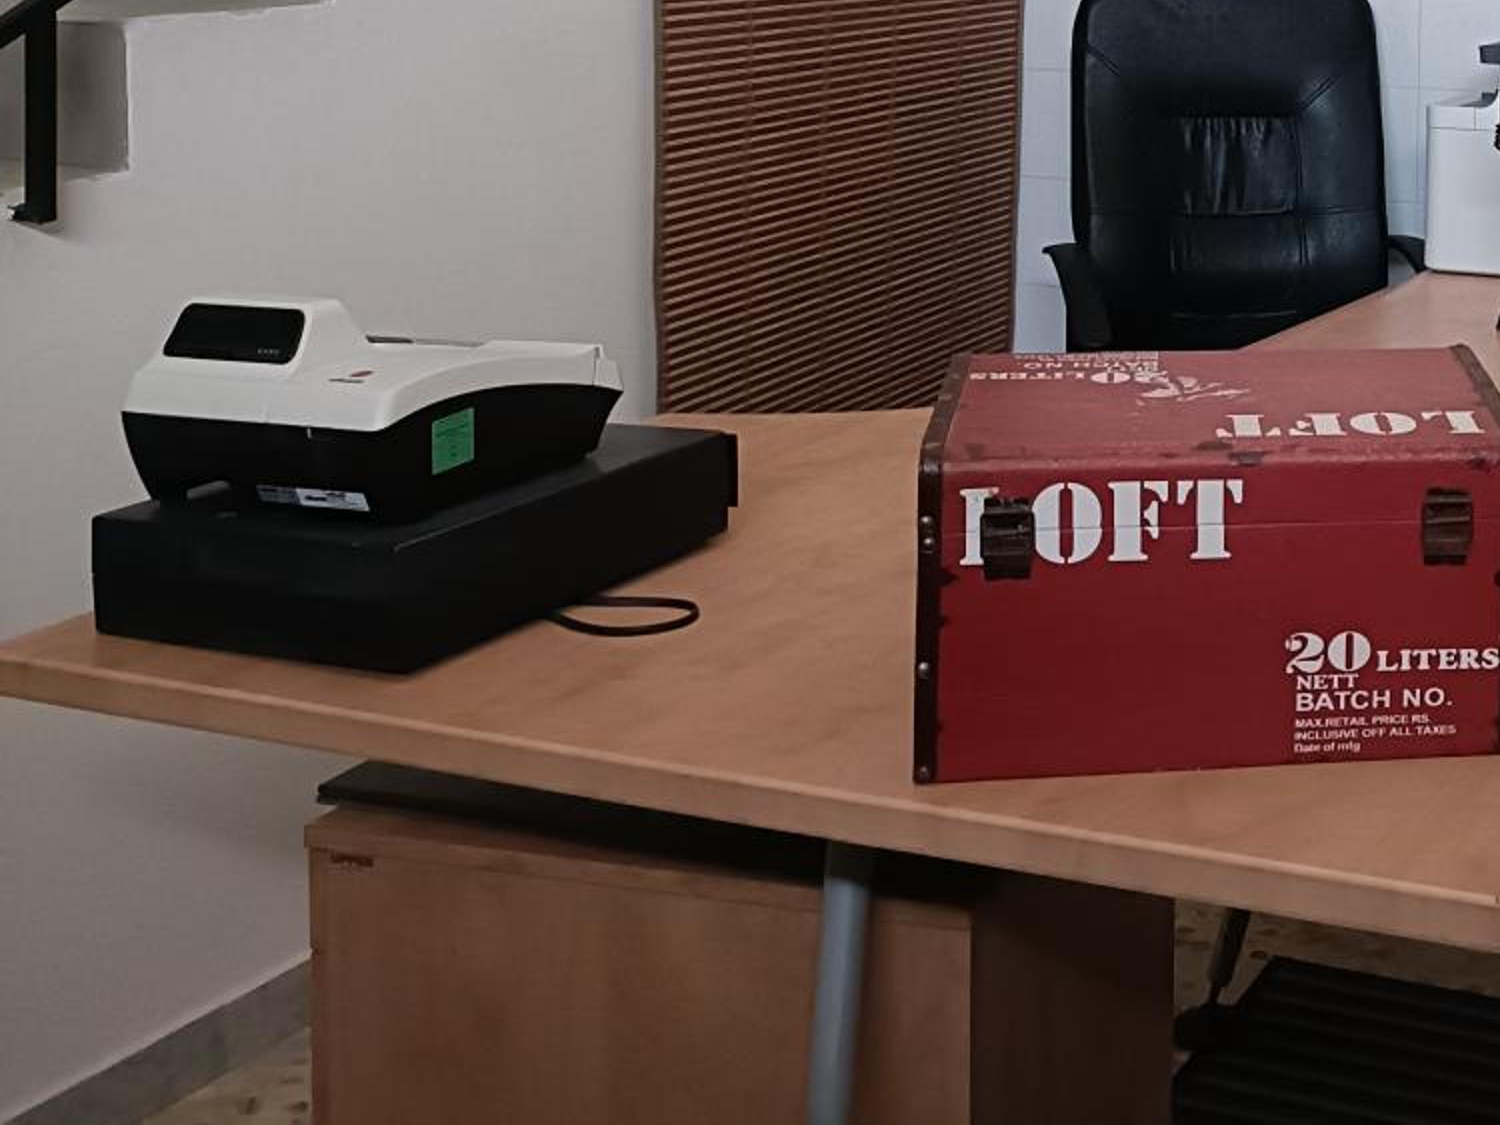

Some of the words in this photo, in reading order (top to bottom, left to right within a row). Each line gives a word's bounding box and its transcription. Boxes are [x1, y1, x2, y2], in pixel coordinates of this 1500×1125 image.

[1215, 411, 1485, 437] LOFT
[1285, 630, 1371, 674] 20
[1376, 648, 1500, 672] LITERS
[1296, 673, 1359, 690] NETT
[1295, 689, 1390, 712] BATCH
[1402, 687, 1453, 707] NO.
[1371, 715, 1408, 725] PRICE
[1294, 729, 1358, 741] INCLUSIVE
[1361, 727, 1385, 737] OFF
[1389, 725, 1411, 736] ALL
[1416, 725, 1456, 735] TAXES
[1294, 743, 1320, 753] Date
[1323, 741, 1335, 751] of
